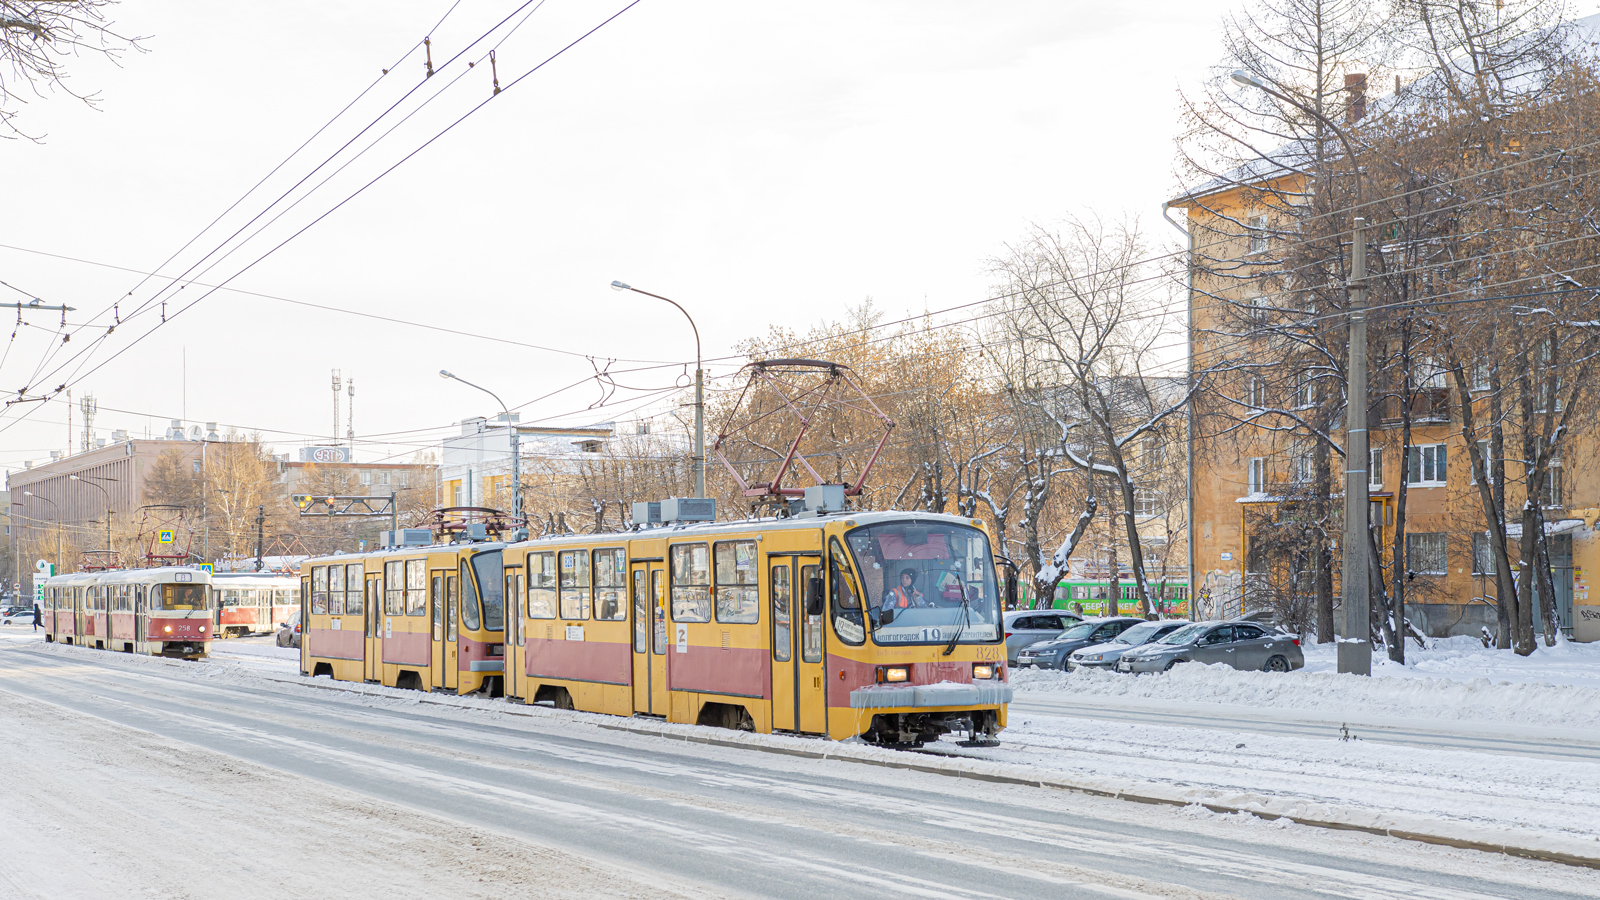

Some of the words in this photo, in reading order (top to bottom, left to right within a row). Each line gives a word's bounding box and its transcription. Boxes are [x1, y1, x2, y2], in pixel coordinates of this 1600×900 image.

[178, 624, 191, 632] 258
[922, 628, 941, 641] 19
[976, 646, 1000, 660] 828
